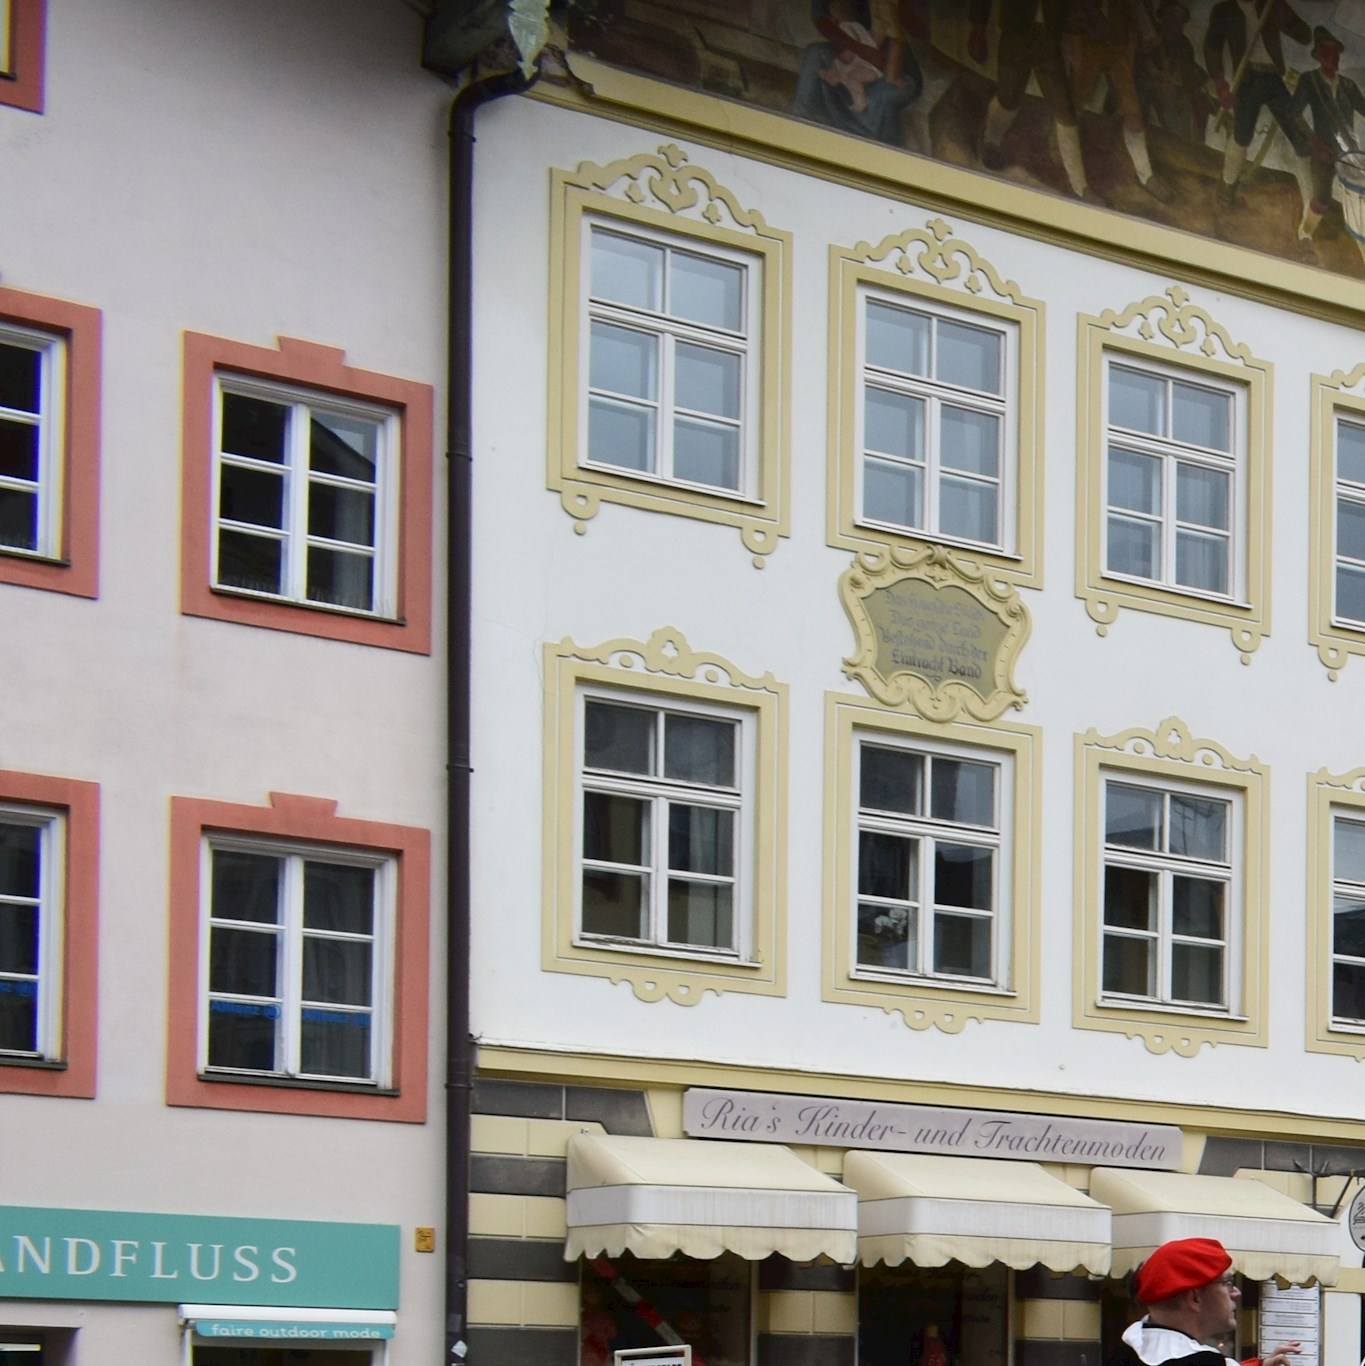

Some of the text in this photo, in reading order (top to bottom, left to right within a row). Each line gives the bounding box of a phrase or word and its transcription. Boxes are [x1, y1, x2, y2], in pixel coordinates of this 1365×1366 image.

[947, 657, 981, 679] Band
[701, 1097, 781, 1133] Ria's
[914, 1118, 973, 1148] und
[974, 1120, 1166, 1162] Trachtenmoden
[0, 1234, 298, 1284] NDFLUSS
[211, 1323, 381, 1339] faire outdoor mode
